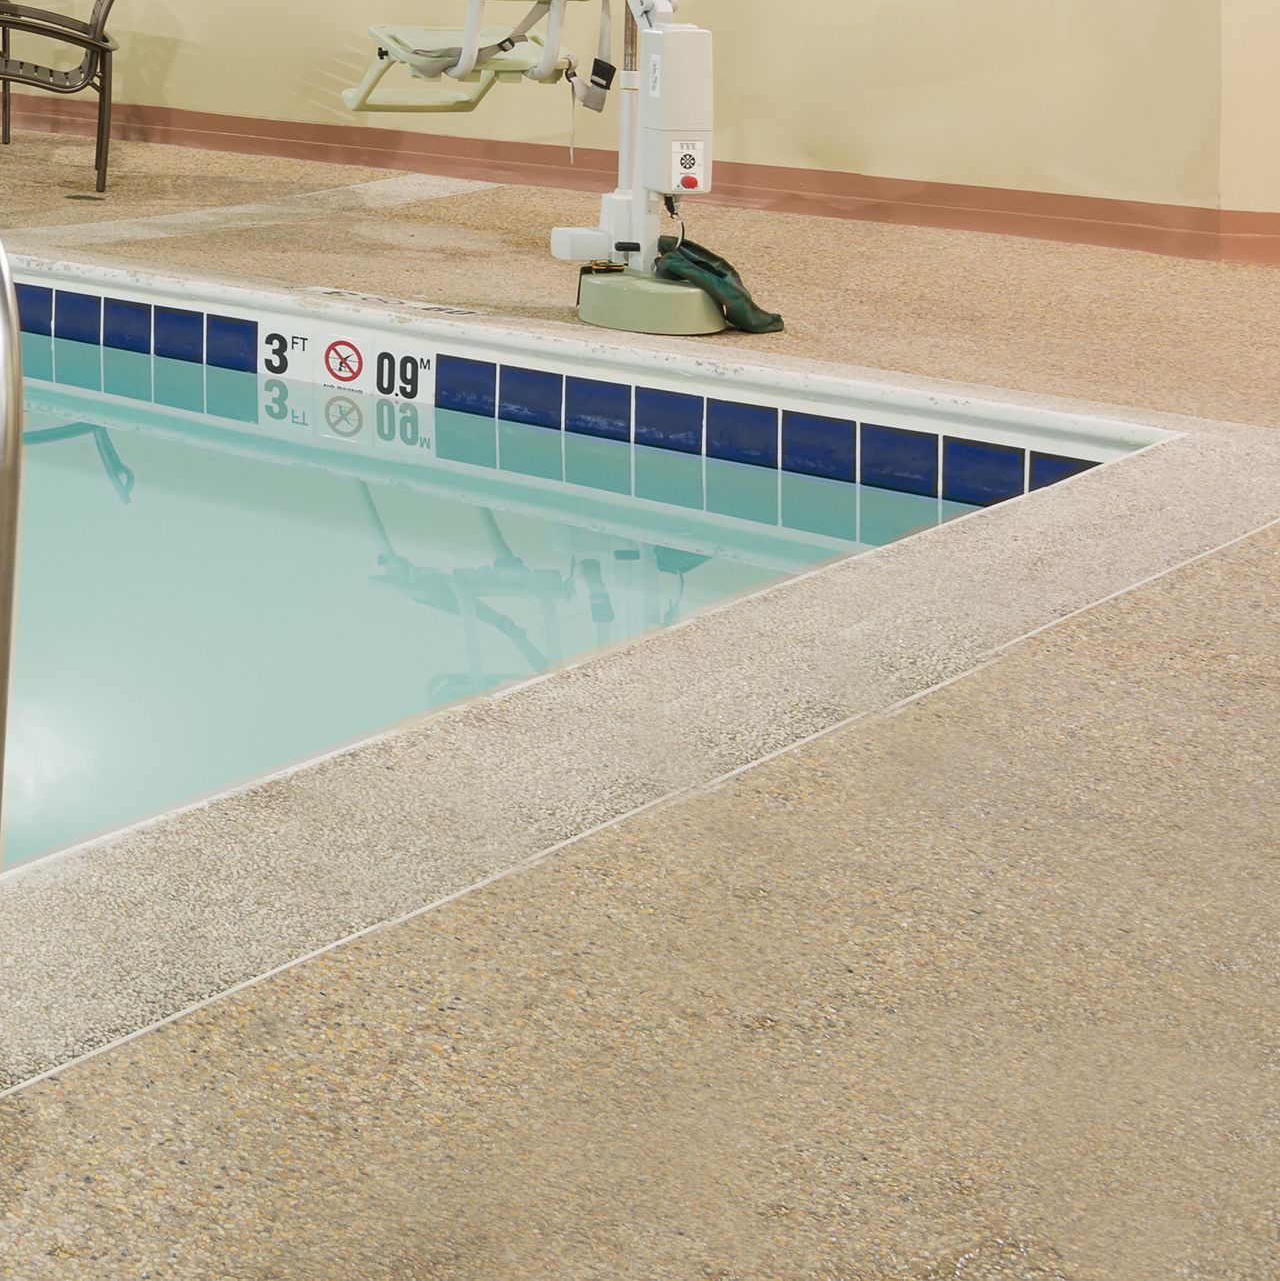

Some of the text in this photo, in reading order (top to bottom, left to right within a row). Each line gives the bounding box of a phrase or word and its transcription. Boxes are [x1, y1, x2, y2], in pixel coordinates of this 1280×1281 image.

[264, 332, 431, 399] 3 FT 0.9 M
